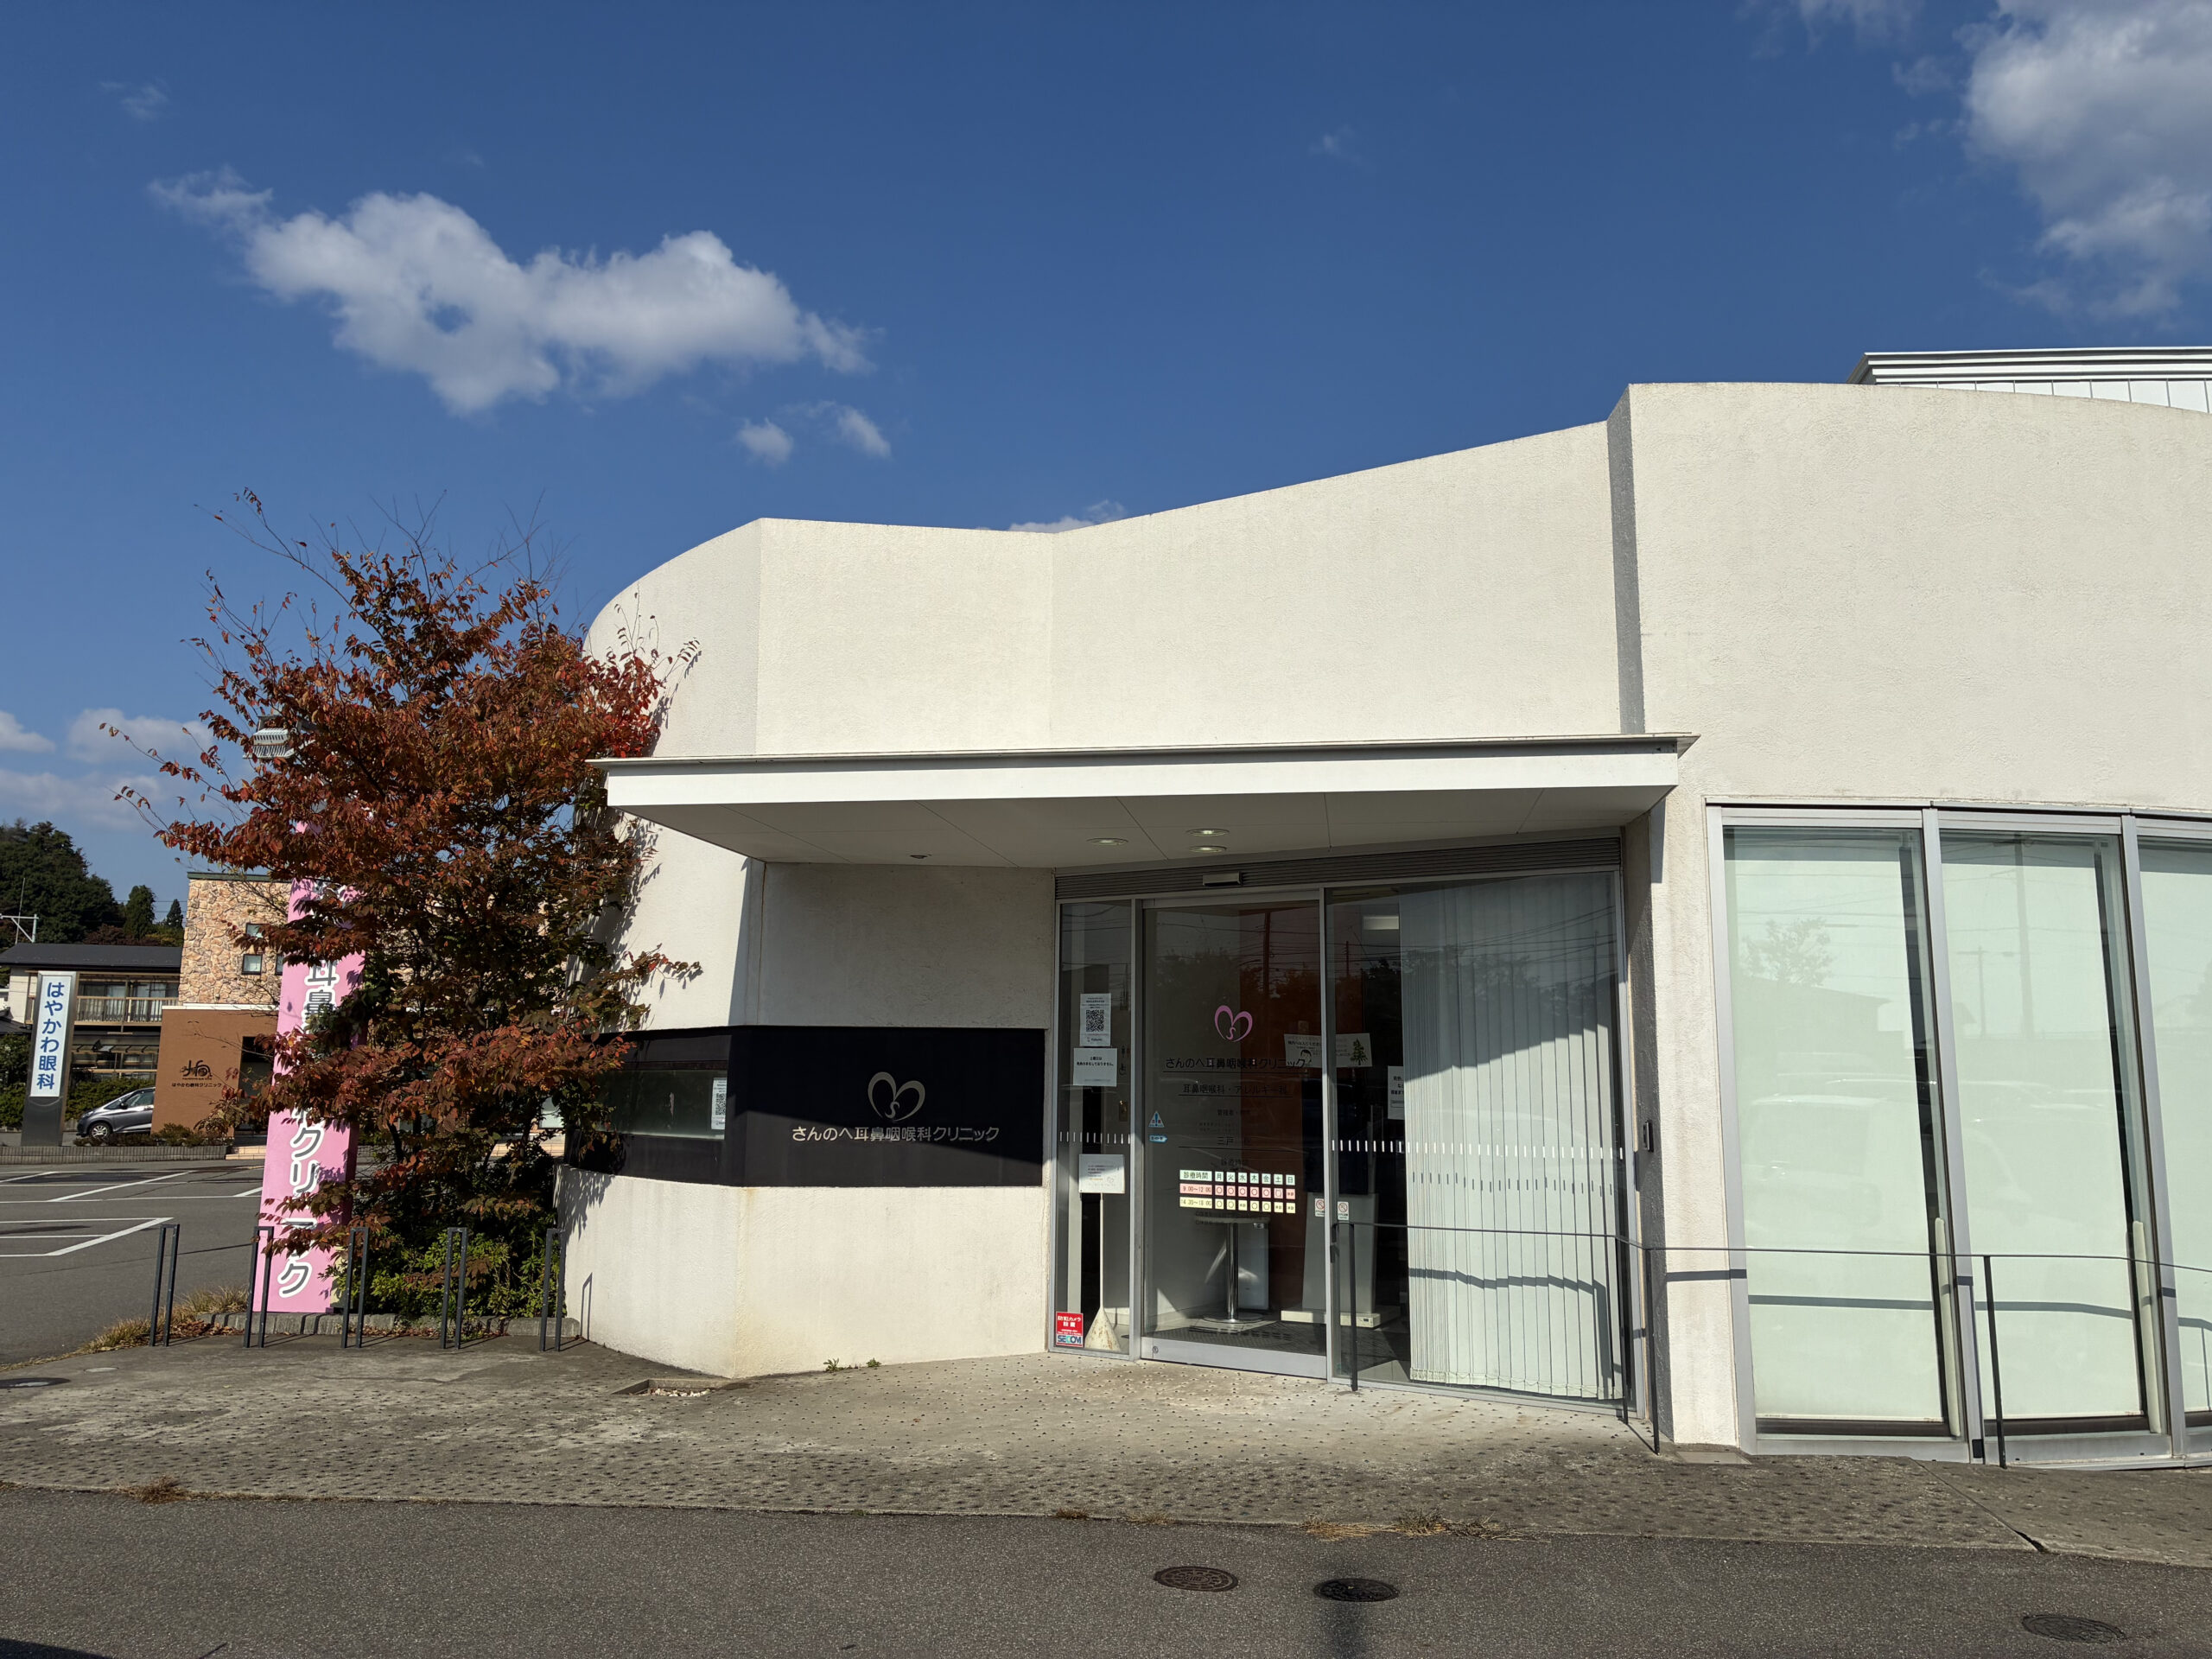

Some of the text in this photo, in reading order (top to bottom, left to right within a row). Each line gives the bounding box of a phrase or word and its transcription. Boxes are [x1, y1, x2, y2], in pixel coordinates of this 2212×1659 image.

[36, 982, 65, 1090] はやかわ眼科
[792, 1126, 1000, 1142] さんのへ耳鼻咽喉科クリニック
[1183, 1171, 1209, 1179] 診療時間
[1216, 1172, 1223, 1180] 月
[1239, 1173, 1247, 1182] 水
[1058, 1335, 1082, 1344] SECOM
